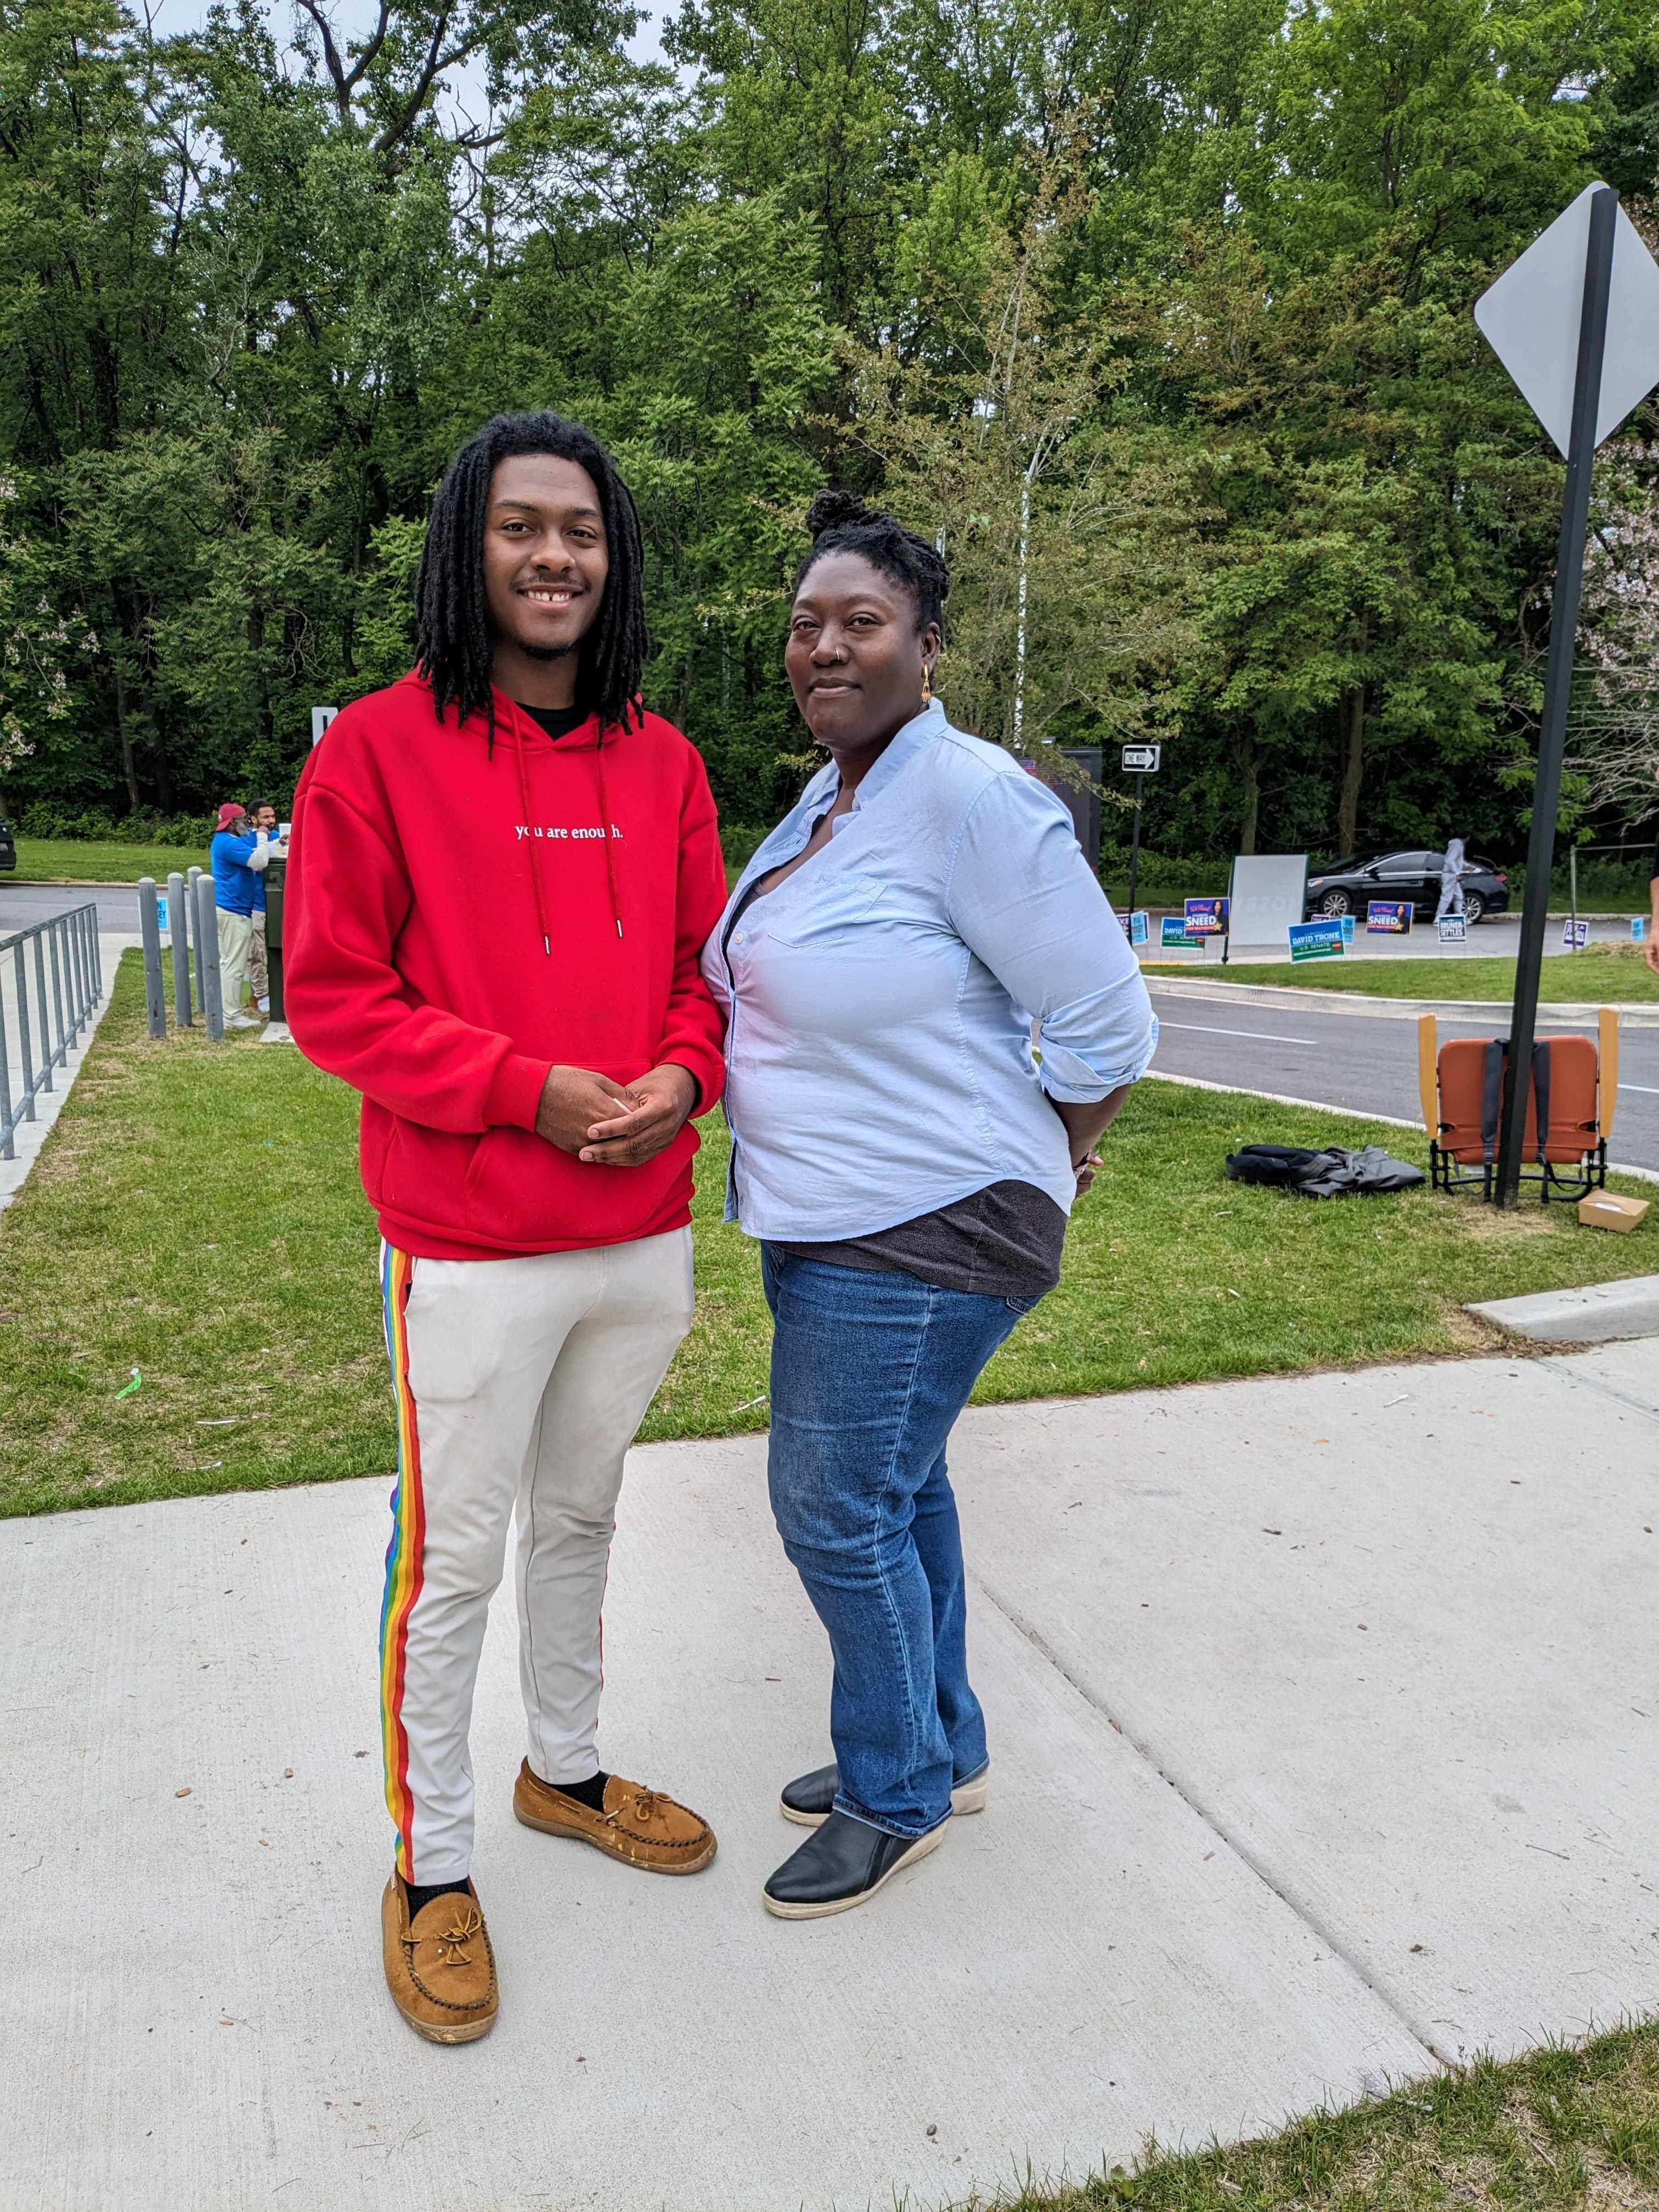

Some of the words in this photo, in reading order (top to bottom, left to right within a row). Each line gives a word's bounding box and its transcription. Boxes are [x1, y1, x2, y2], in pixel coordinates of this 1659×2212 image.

[1136, 754, 1146, 763] WAY
[546, 827, 568, 838] are
[571, 824, 623, 839] enouh.
[1186, 915, 1216, 927] SNEED
[1368, 915, 1398, 926] SNEED
[1292, 935, 1313, 945] DAVID
[1314, 932, 1340, 942] TRONE
